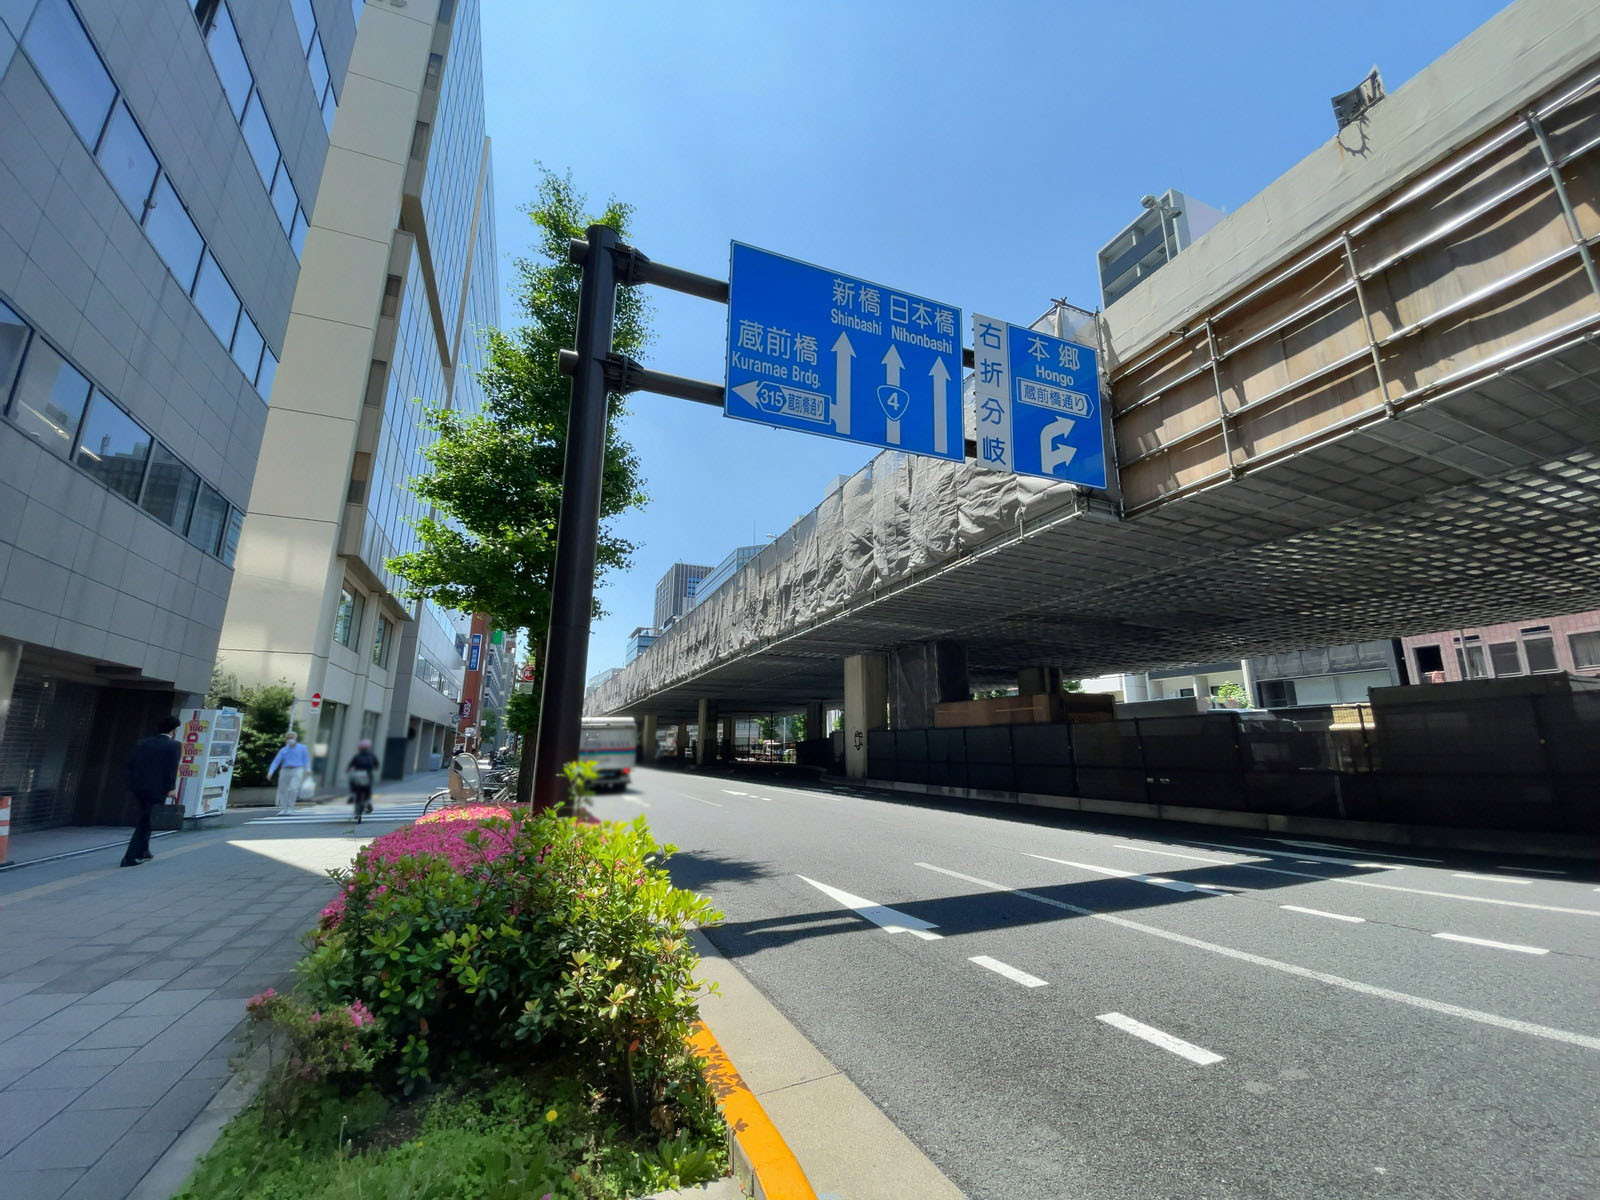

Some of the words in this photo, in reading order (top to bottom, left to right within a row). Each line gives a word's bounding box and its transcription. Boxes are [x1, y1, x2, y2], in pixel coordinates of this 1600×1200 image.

[832, 278, 881, 317] 新橋
[890, 294, 955, 337] 日本橋
[737, 319, 818, 366] 蔵前橋
[830, 308, 882, 336] Shinbashi
[891, 325, 953, 354] Nihonbashi
[731, 351, 788, 380] Kuramae
[792, 365, 821, 388] Brdg.
[1027, 336, 1081, 371] 本郷
[979, 322, 1006, 465] 右折分岐
[1036, 364, 1075, 387] Hongo
[760, 389, 783, 407] 315
[887, 392, 900, 411] 4
[1024, 383, 1086, 412] 蔵前橋通り
